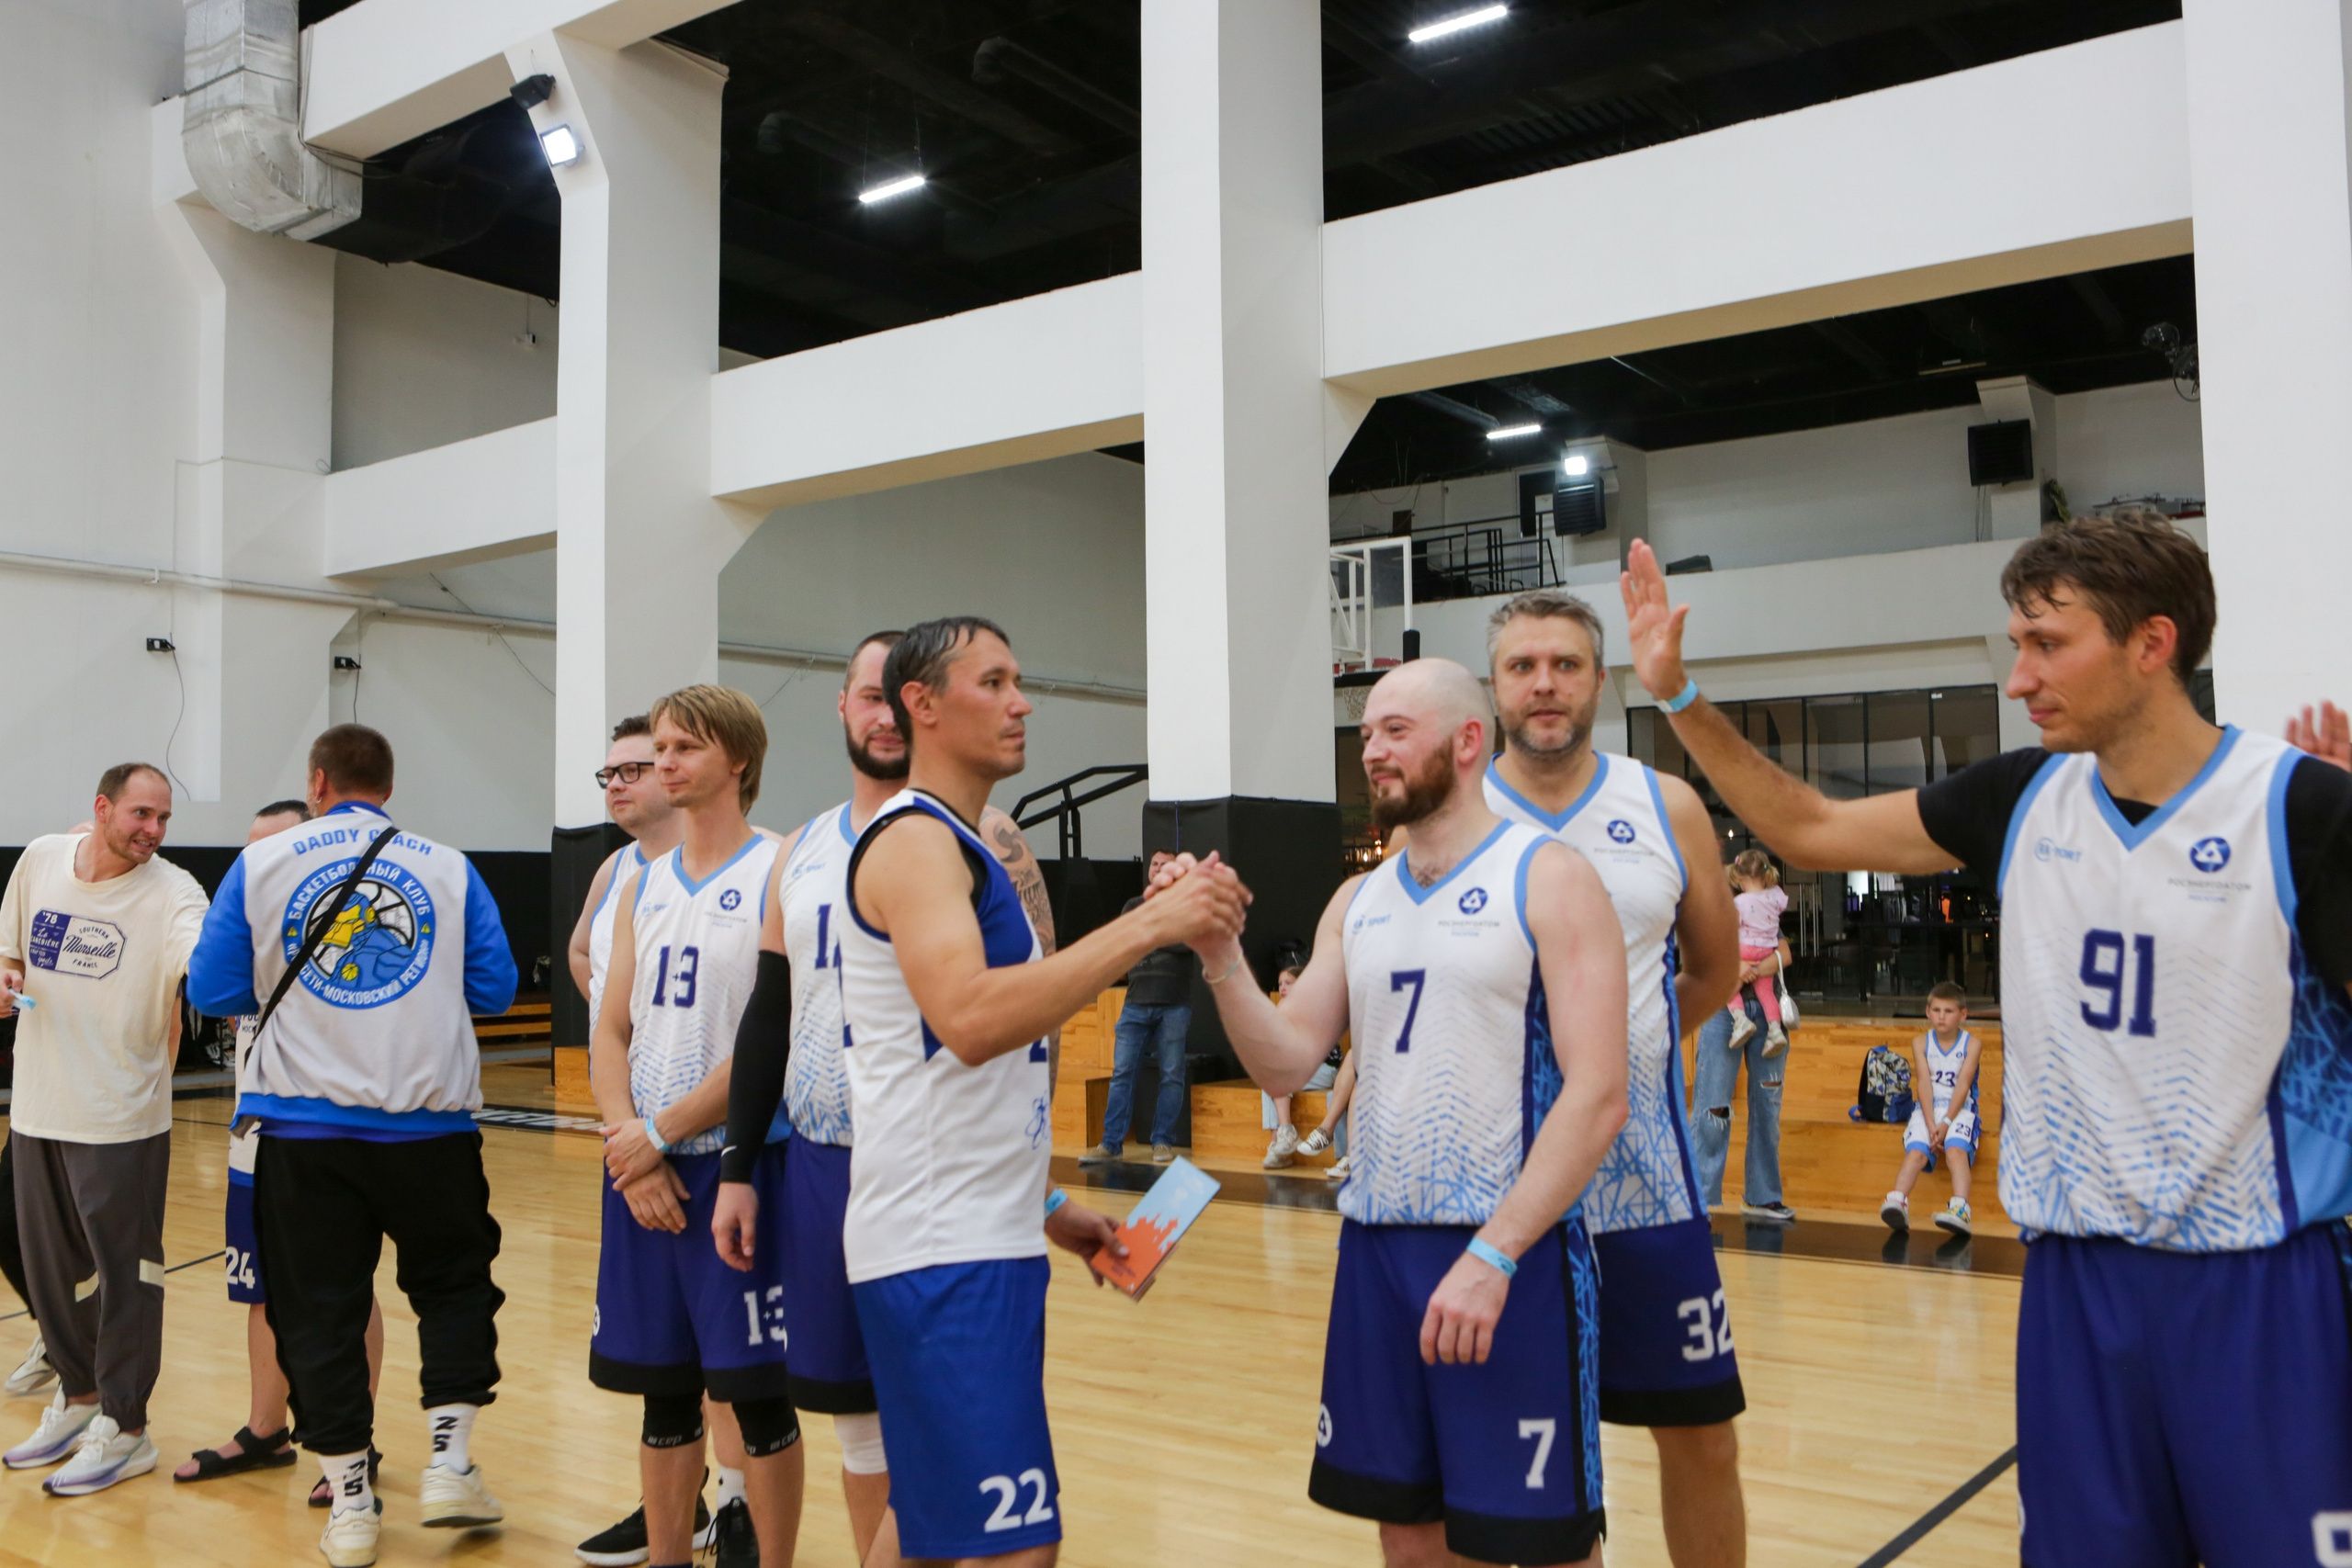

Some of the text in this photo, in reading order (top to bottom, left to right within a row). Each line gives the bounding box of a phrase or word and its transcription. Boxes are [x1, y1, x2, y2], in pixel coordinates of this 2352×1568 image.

[293, 829, 433, 856] DADDY CACH
[288, 861, 432, 920] БАСКЕТБОЛНЫЙ КЛУБ
[62, 934, 118, 959] Marseille
[79, 925, 109, 940] SOUTHERN
[814, 903, 842, 970] 1
[73, 958, 98, 969] FRANCE
[651, 945, 699, 1009] 13
[2079, 928, 2156, 1038] 91
[1390, 968, 1426, 1054] 7
[1935, 1070, 1956, 1088] 23
[1955, 1122, 1972, 1138] 23
[225, 1246, 256, 1290] 24
[1677, 1288, 1735, 1361] 32
[1518, 1418, 1556, 1489] 7
[978, 1468, 1055, 1534] 22
